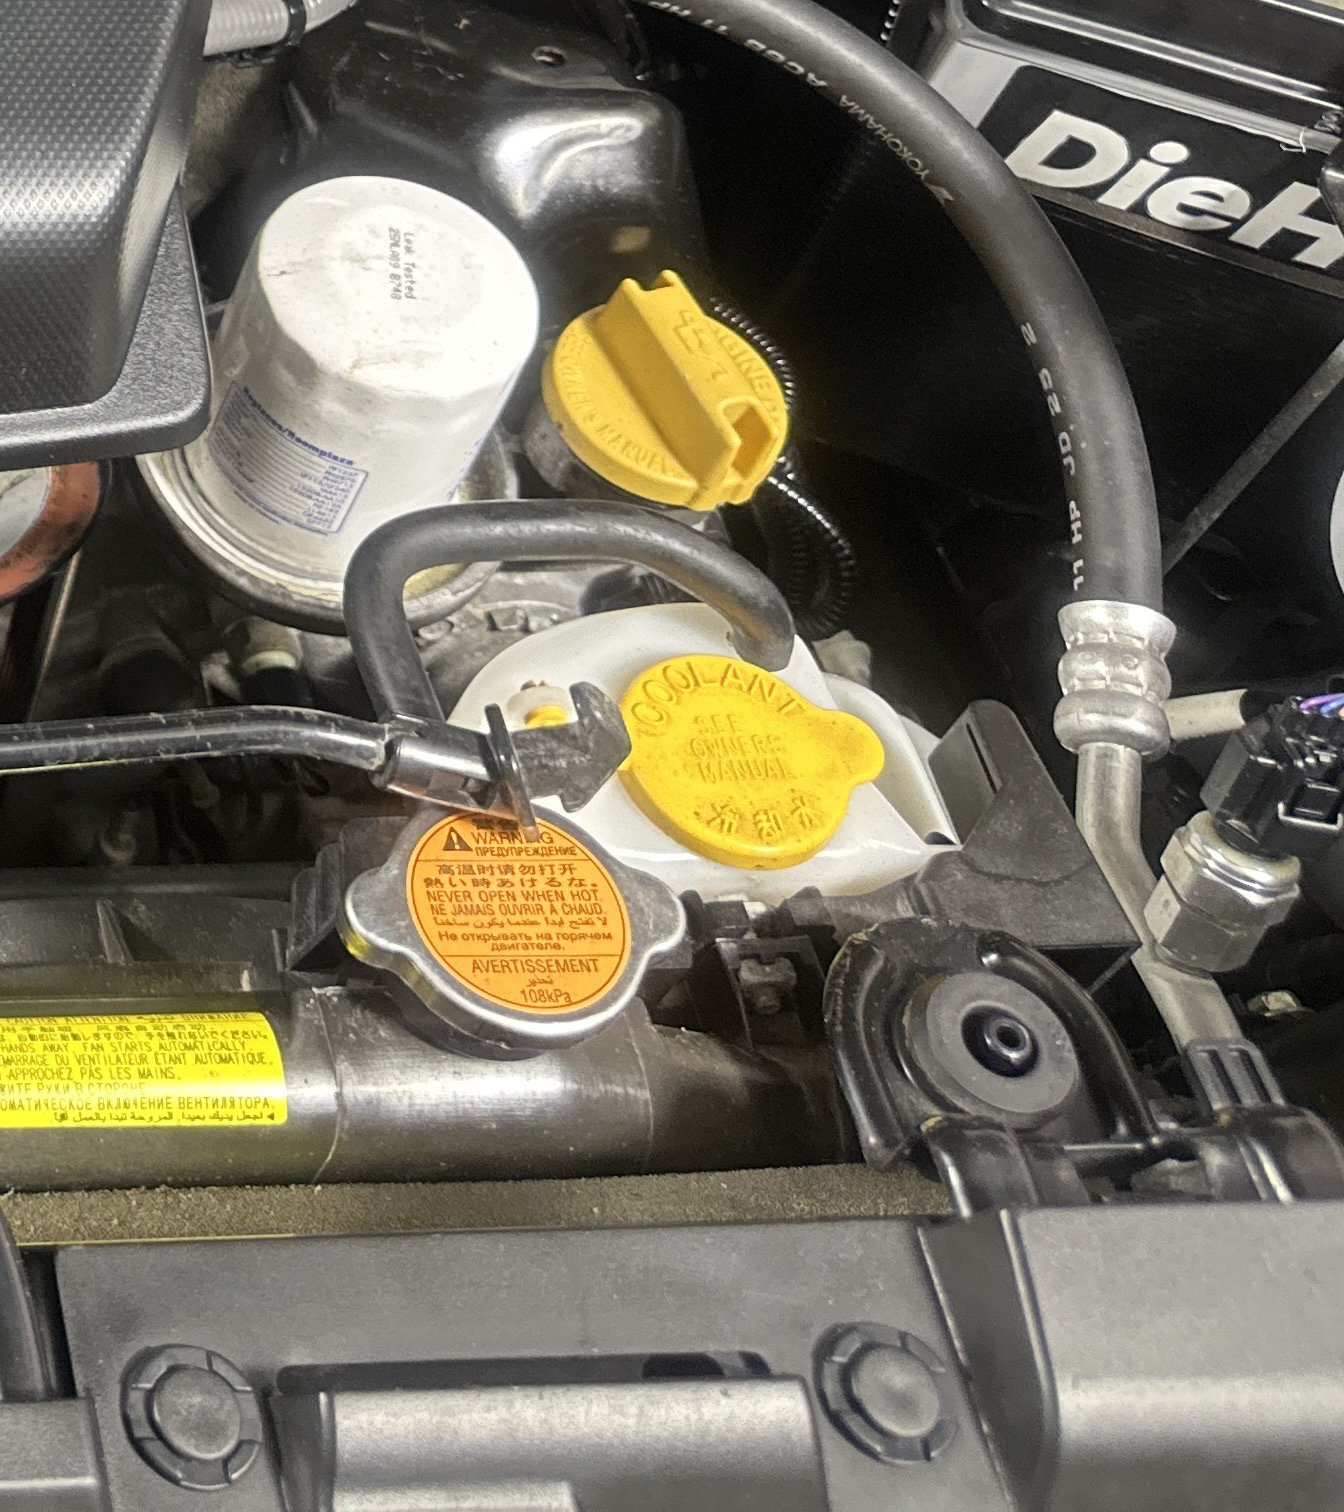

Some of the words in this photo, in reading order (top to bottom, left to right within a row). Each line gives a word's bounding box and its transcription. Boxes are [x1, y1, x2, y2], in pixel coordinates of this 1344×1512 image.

[839, 94, 930, 181] YOKOHAMA
[404, 262, 417, 300] Tested
[1068, 500, 1082, 545] HP
[631, 661, 805, 725] COOLANT
[694, 713, 738, 734] SEE
[696, 757, 791, 782] MANUAL
[471, 831, 554, 845] WARNG
[475, 846, 577, 857] ПРЕДУПРЕЖДЕНИЕ
[436, 864, 577, 876] 高温时请勿打开
[426, 890, 473, 903] NEVER
[479, 890, 516, 902] OPEN
[522, 890, 564, 902] WHEN
[430, 903, 447, 916] NE
[451, 903, 495, 916] JAMAIS
[498, 903, 544, 915] OUVRIR
[438, 931, 457, 941] Не
[461, 932, 532, 944] открывать
[535, 932, 553, 941] на
[556, 931, 613, 944] горячем
[471, 959, 600, 974] AVERTISSEMENT
[519, 989, 572, 1004] 108kPa
[0, 1043, 36, 1053] HANDS
[83, 1042, 104, 1052] FAN
[112, 1041, 152, 1051] STARTS
[55, 1054, 70, 1066] DU
[75, 1053, 149, 1065] VENTILATEUR
[155, 1051, 187, 1065] ÉTANT
[8, 1068, 74, 1081] APPROCHEZ
[79, 1067, 103, 1081] PAS
[110, 1068, 132, 1080] LES
[138, 1067, 181, 1080] MAINS.
[37, 1082, 70, 1095] РУКИ
[98, 1097, 173, 1110] ВКЛЮЧЕНИЕ
